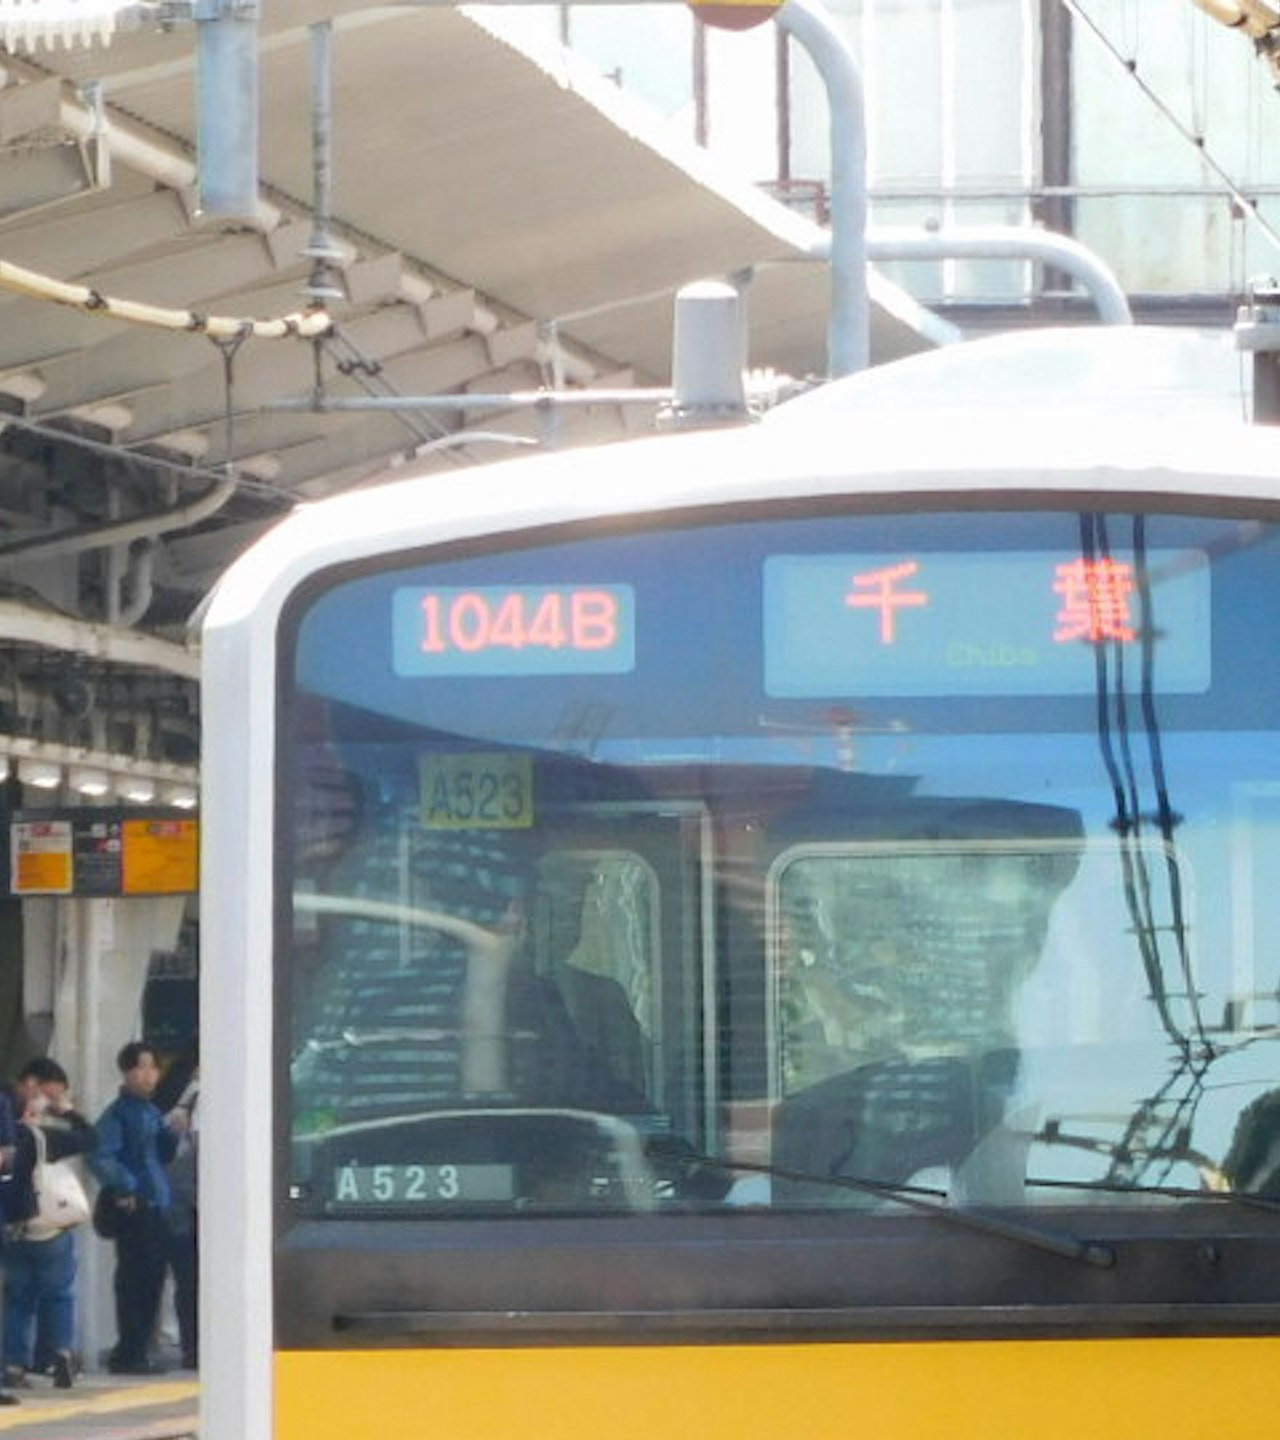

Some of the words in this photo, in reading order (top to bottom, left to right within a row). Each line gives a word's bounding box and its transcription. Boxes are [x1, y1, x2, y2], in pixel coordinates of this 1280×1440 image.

[420, 588, 616, 652] 1044B
[428, 769, 524, 821] A523
[337, 1164, 460, 1201] A523
